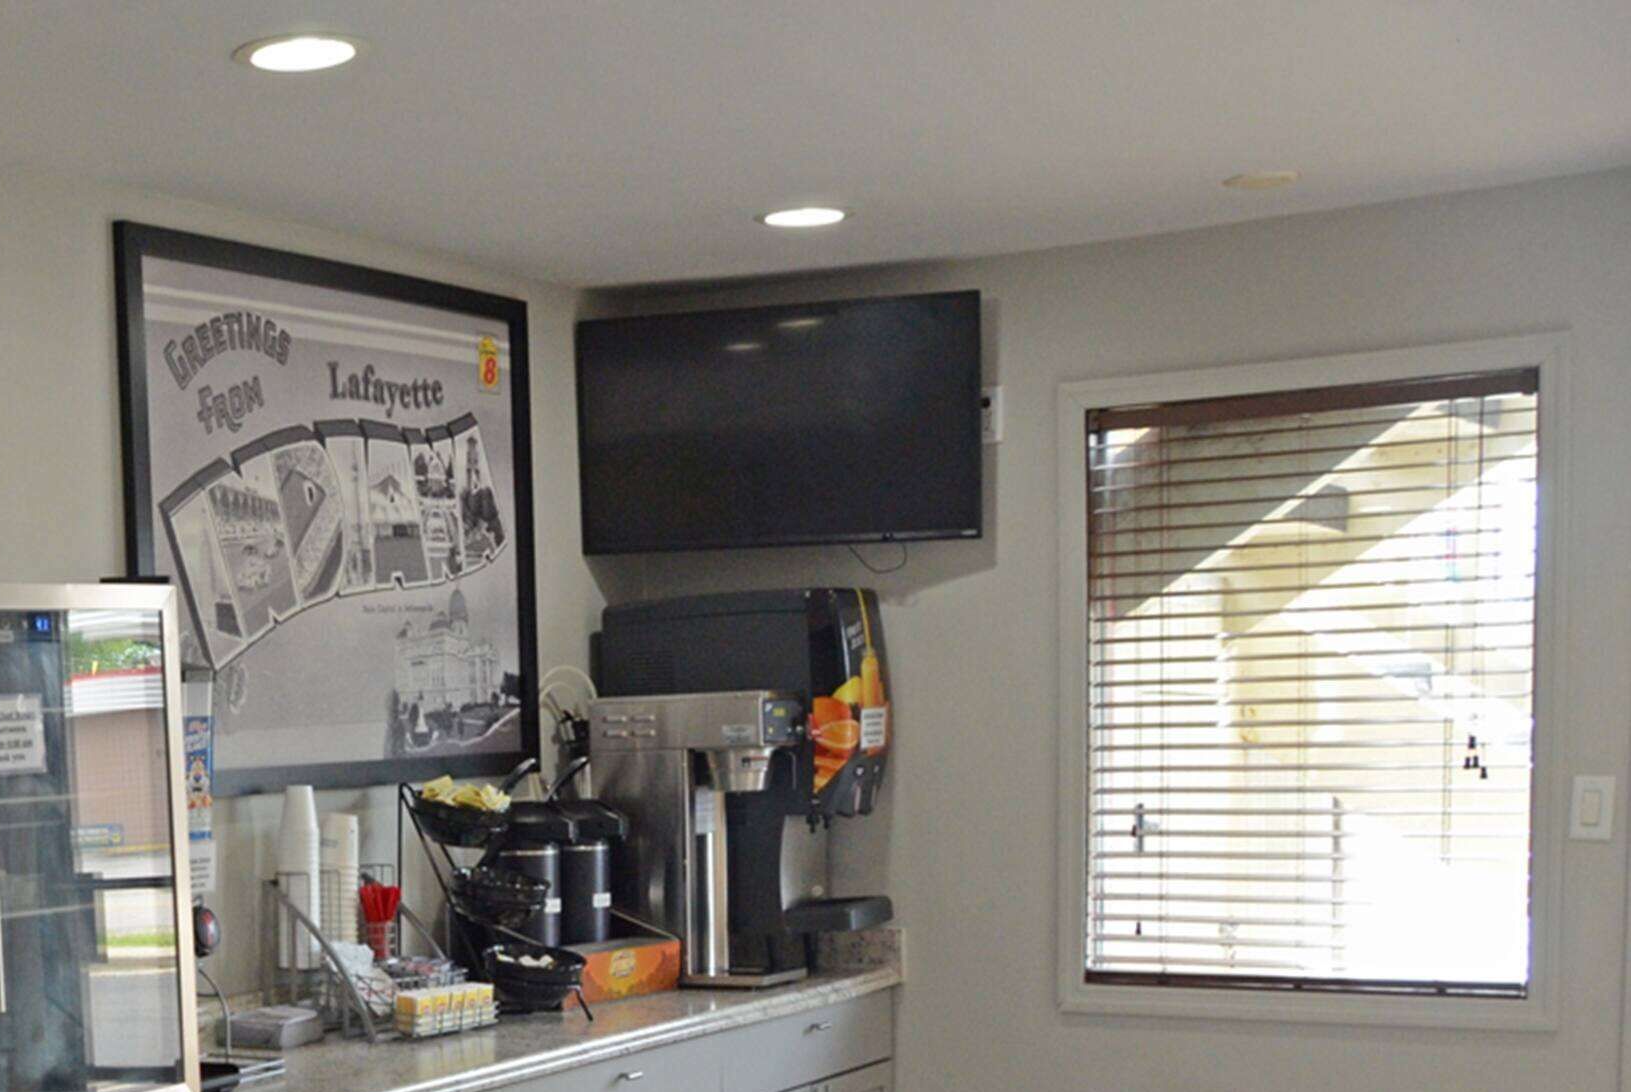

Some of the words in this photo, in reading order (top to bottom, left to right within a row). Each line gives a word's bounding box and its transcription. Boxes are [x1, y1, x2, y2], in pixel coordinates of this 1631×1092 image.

[163, 311, 292, 391] GREETINGS
[483, 357, 496, 385] 8
[196, 374, 266, 435] FROM
[326, 361, 445, 418] Lafayette
